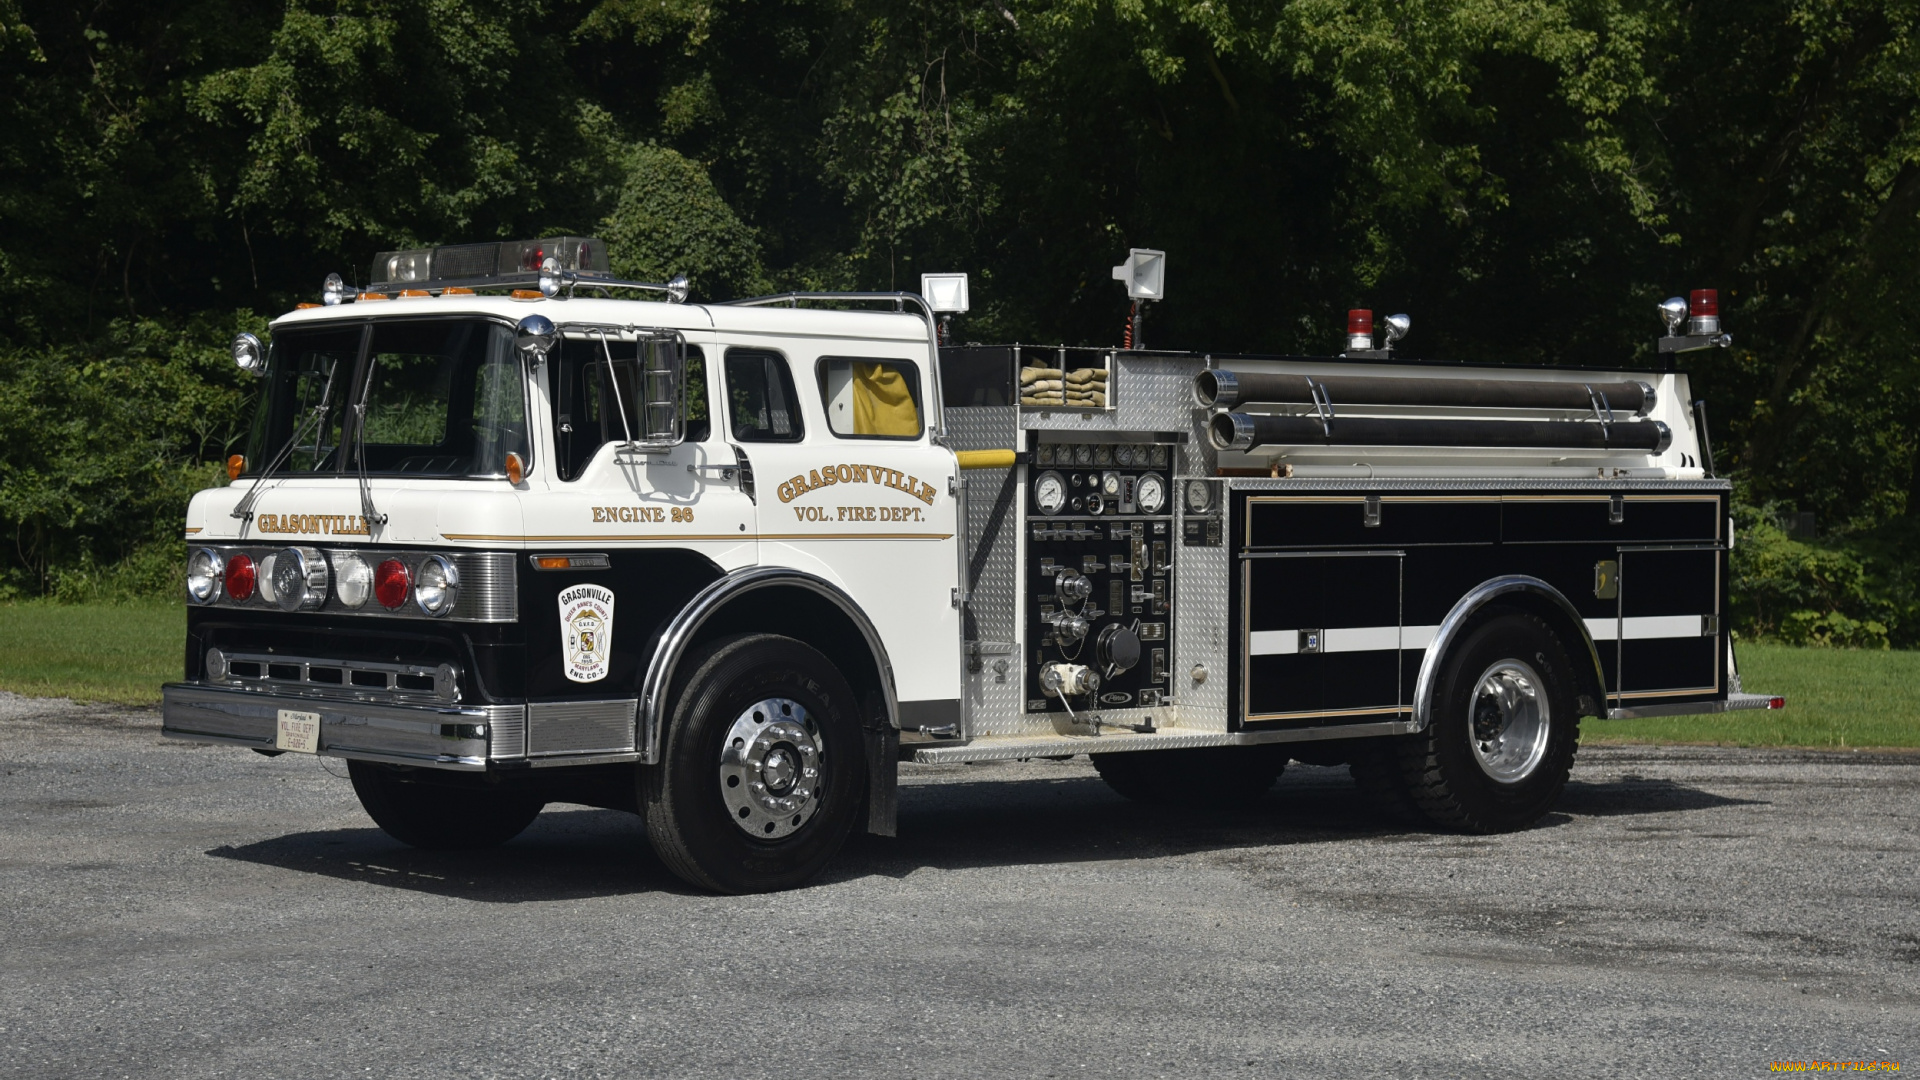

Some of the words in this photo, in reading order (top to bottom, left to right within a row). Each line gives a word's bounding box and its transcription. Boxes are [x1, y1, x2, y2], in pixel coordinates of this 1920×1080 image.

[777, 464, 937, 505] GRASONVILLE
[592, 506, 666, 523] ENGINE
[671, 506, 695, 523] 26
[794, 506, 833, 522] VOL.
[837, 506, 877, 522] FIRE
[880, 506, 925, 522] DEPT.
[258, 514, 371, 536] GRASONVILLE
[561, 588, 612, 606] GRASONVILLE
[565, 607, 577, 622] QUEEN
[577, 601, 593, 610] ANNE'S
[593, 603, 609, 621] COUNTY
[569, 668, 585, 680] ENG.
[574, 663, 600, 672] MARYLAND
